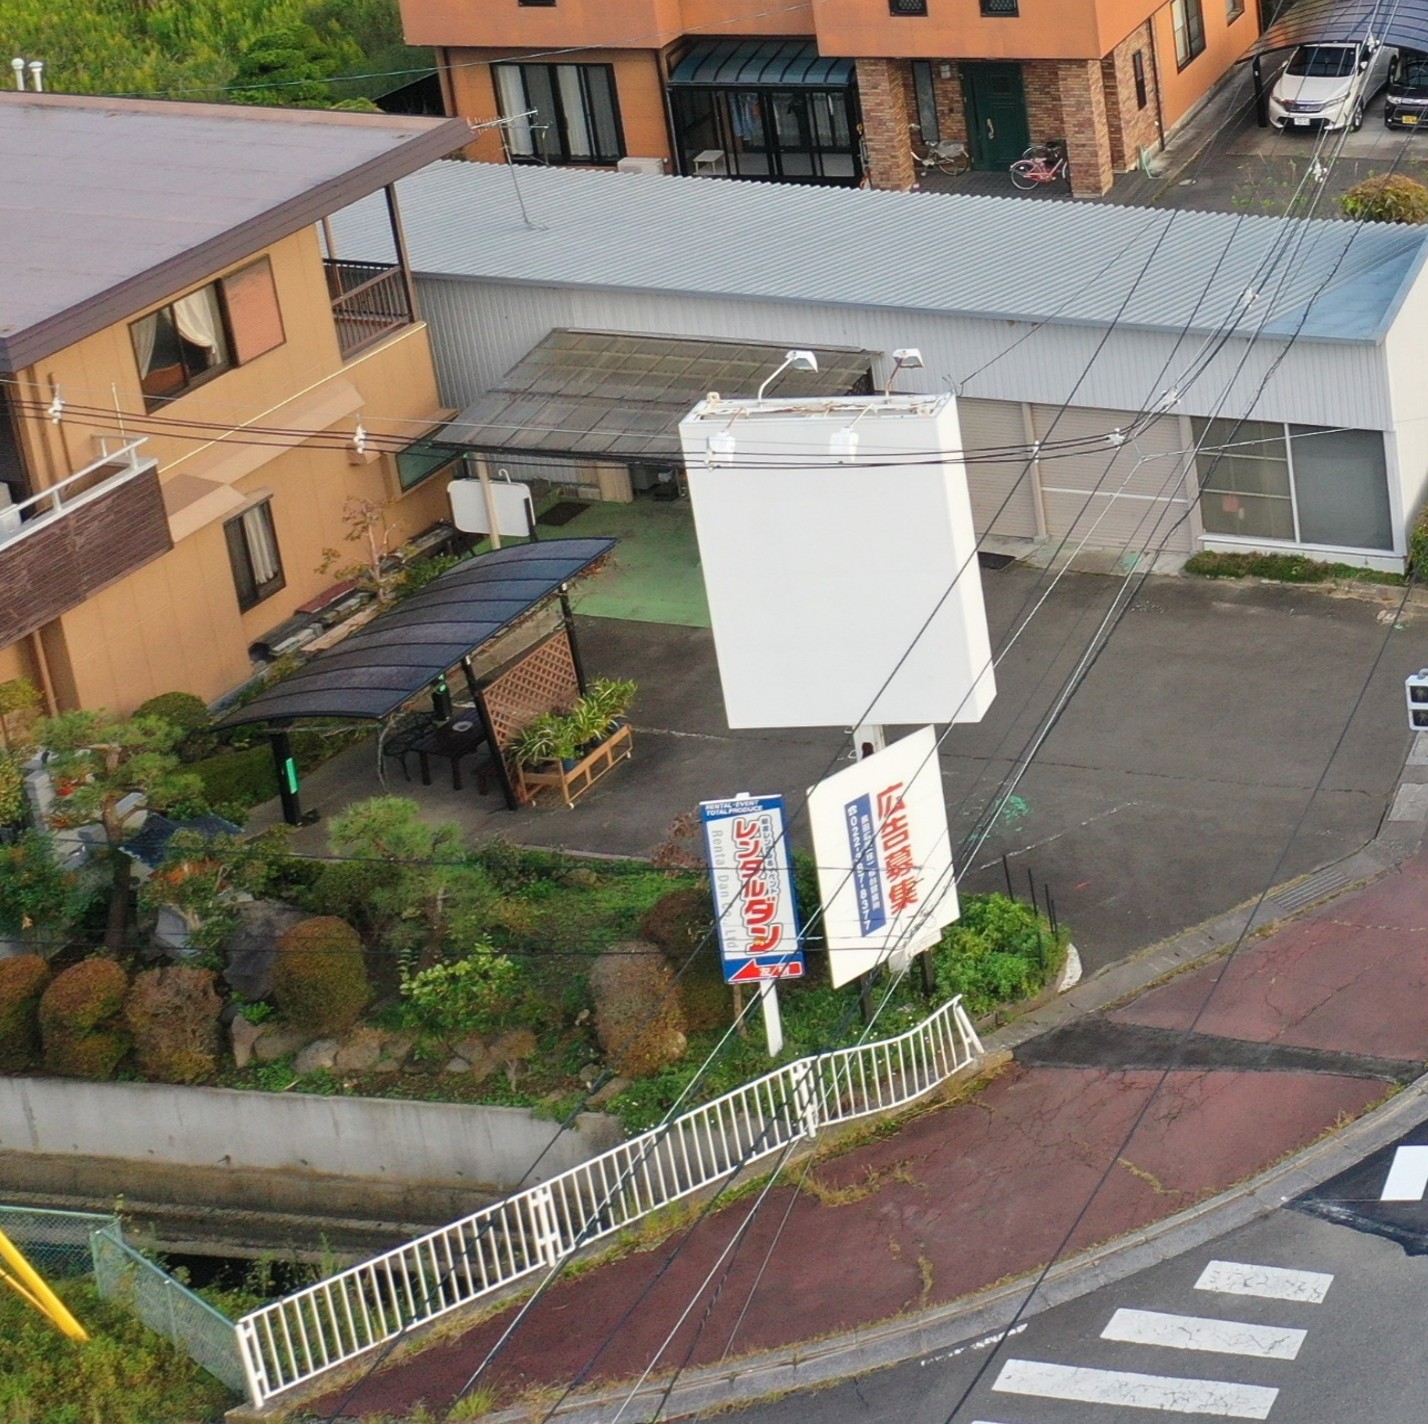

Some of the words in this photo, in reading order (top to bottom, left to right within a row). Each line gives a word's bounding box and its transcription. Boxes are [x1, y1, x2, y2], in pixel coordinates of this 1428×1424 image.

[734, 819, 781, 953] レンタルダン
[876, 780, 919, 916] 広告募集
